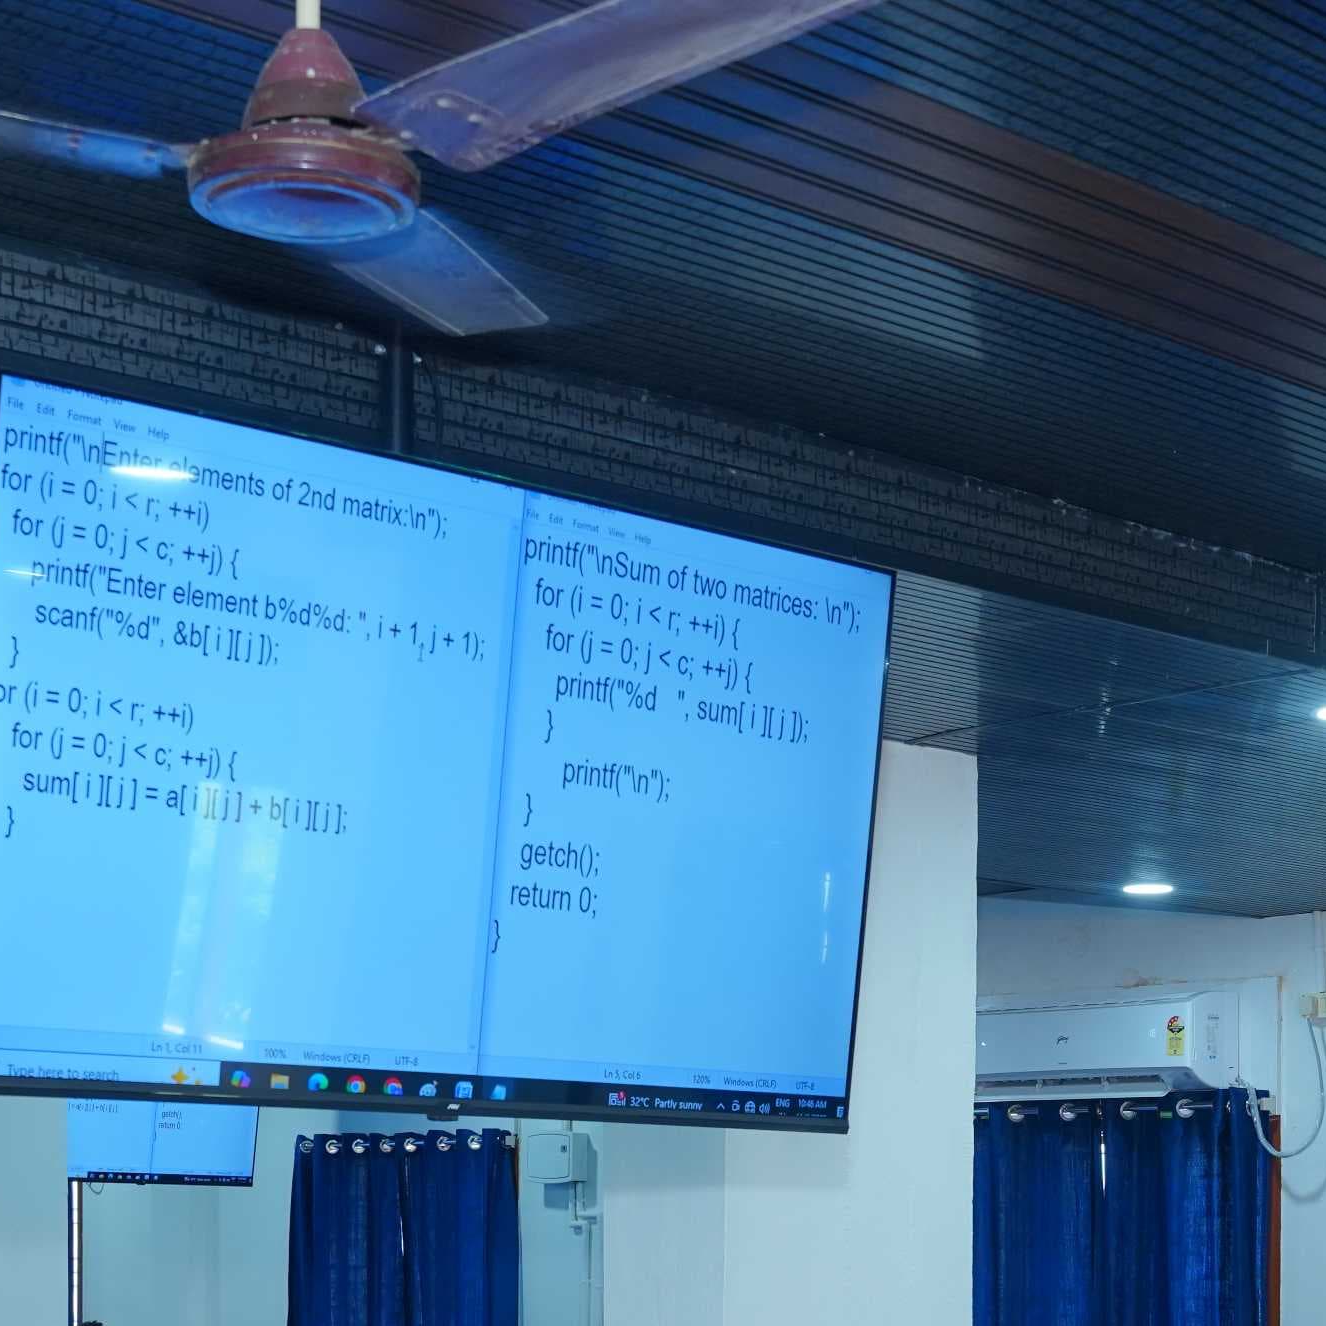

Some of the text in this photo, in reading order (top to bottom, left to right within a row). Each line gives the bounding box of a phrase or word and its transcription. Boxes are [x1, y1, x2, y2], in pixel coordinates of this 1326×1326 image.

[6, 395, 170, 442] File Edit Format View Help
[1, 464, 209, 533] for (i = 0; i < r; ++i)
[170, 455, 267, 498] elements
[272, 478, 293, 503] of
[297, 482, 335, 511] 2nd
[343, 497, 446, 539] matrix:\n");
[12, 508, 239, 579] for (j = 0; j < c; ++j) {
[31, 558, 166, 600] printf("Enter
[172, 581, 258, 617] element
[265, 595, 350, 633] b%d%d:
[378, 616, 382, 638] i
[389, 624, 400, 638] +
[429, 625, 436, 654] j
[443, 632, 454, 647] +
[462, 632, 484, 661] 1);
[524, 535, 860, 633] printf("\nSum of two matrices: \n");
[35, 605, 163, 647] scanf("%d",
[173, 621, 210, 656] &b[
[216, 627, 220, 651] i
[245, 632, 251, 662] j
[258, 634, 278, 665] ]);
[536, 577, 740, 650] for (i = 0; i < r; ++i) {
[9, 636, 19, 668] }
[546, 623, 752, 694] for (j = 0; j < c; ++j) {
[24, 682, 37, 713] (i
[45, 690, 59, 703] =
[68, 688, 87, 718] 0;
[96, 691, 101, 716] i
[109, 699, 122, 714] <
[131, 703, 144, 725] r;
[153, 703, 193, 734] ++i)
[544, 709, 553, 743] }
[556, 672, 656, 711] printf("%d
[697, 701, 745, 733] sum[
[751, 704, 755, 728] i
[778, 709, 784, 740] j
[790, 711, 808, 743] ]);
[12, 722, 237, 781] for (j = 0; j < c; ++j) {
[22, 771, 79, 803] sum[
[86, 773, 90, 799] i
[117, 777, 123, 808] j
[129, 778, 137, 810] ]
[145, 787, 158, 799] =
[166, 784, 187, 816] a[
[192, 786, 197, 811] i
[270, 796, 289, 828] b[
[334, 804, 347, 834] ];
[562, 760, 669, 803] printf("\n");
[5, 805, 14, 838] }
[523, 793, 532, 827] }
[520, 841, 599, 878] getch();
[510, 882, 597, 918] return 0;
[492, 919, 501, 953] }
[303, 1048, 340, 1063] Windows
